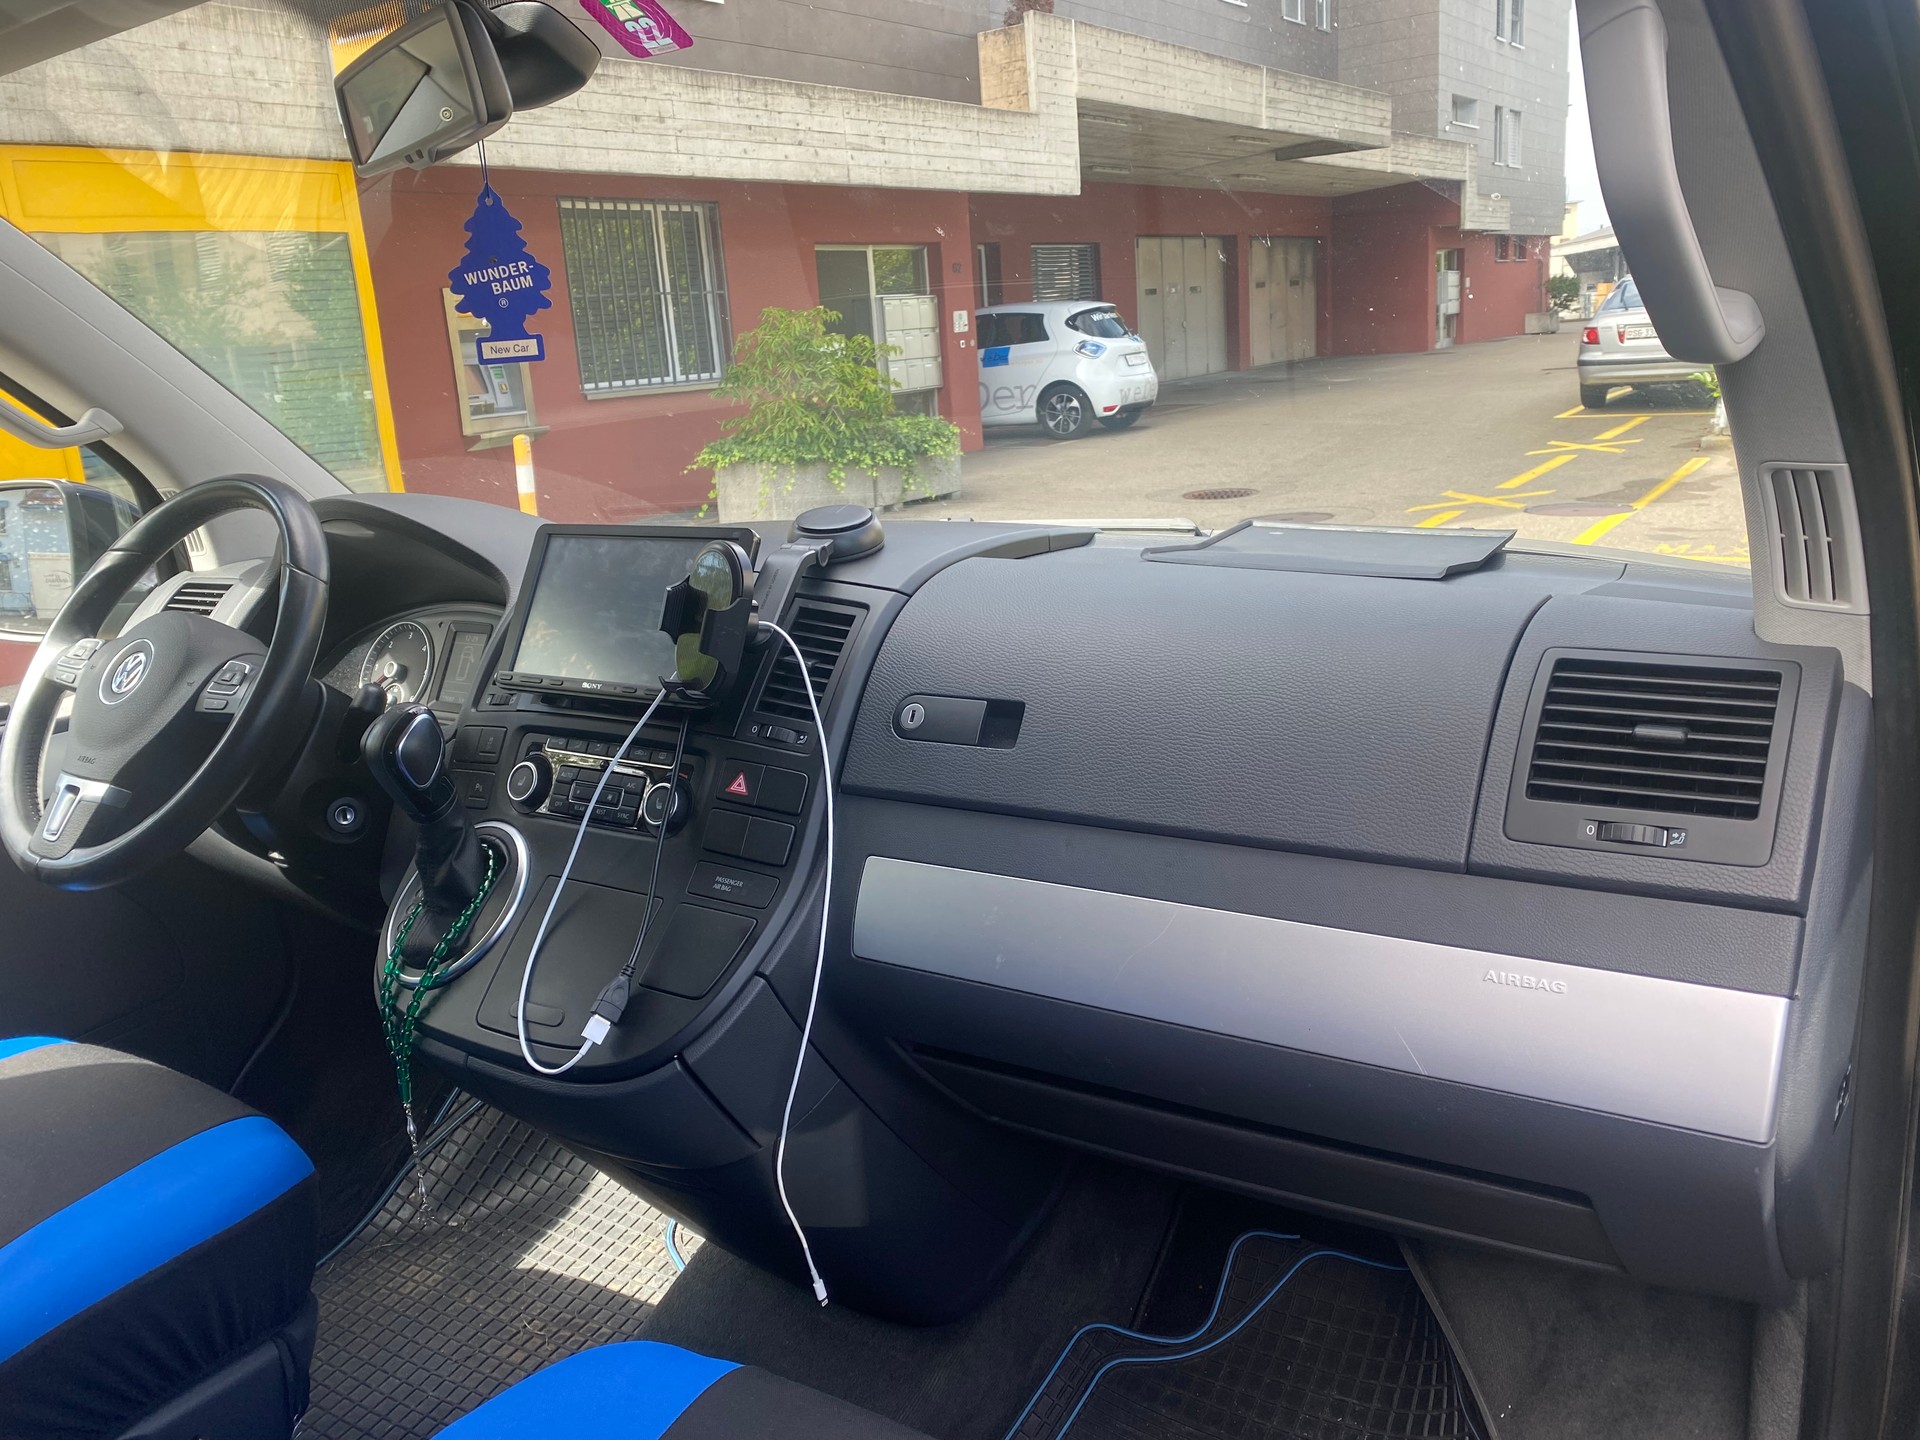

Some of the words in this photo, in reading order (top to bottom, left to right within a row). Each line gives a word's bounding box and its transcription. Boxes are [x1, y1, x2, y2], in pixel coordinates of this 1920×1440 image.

[464, 260, 534, 286] WUNDER-
[491, 275, 534, 295] BAUM
[490, 345, 510, 354] New
[513, 343, 530, 353] Car
[715, 875, 744, 888] PASSENGER
[1482, 969, 1567, 994] AIRBAG
